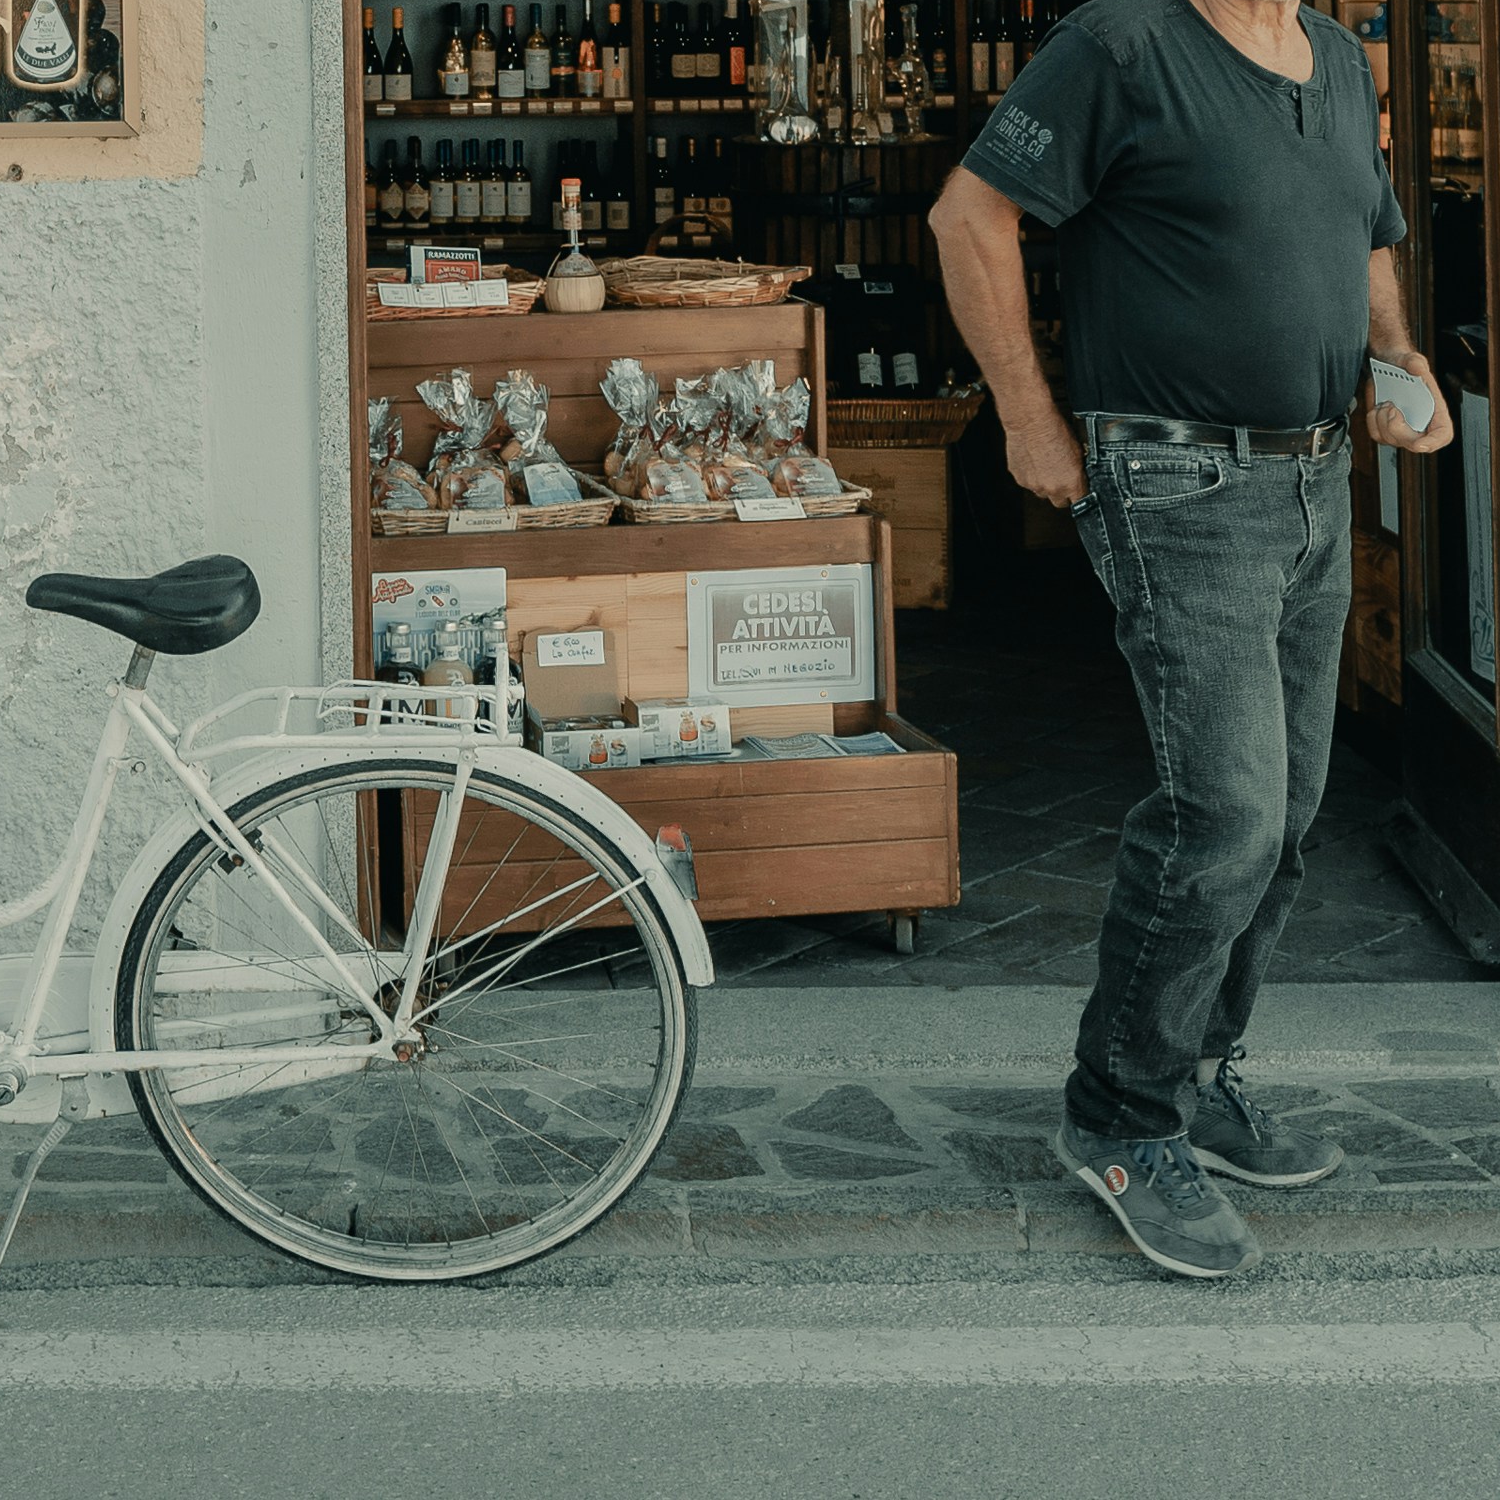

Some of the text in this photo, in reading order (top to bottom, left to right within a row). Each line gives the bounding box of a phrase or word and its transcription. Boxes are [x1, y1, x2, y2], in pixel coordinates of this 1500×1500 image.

[1004, 105, 1039, 135] JACK &
[428, 251, 475, 260] RAMAZZOTTI
[466, 518, 502, 526] Cantucci
[743, 590, 823, 615] CEDESI
[732, 609, 835, 639] ATTIVITÀ
[720, 639, 848, 654] PER INFORMAZIONI
